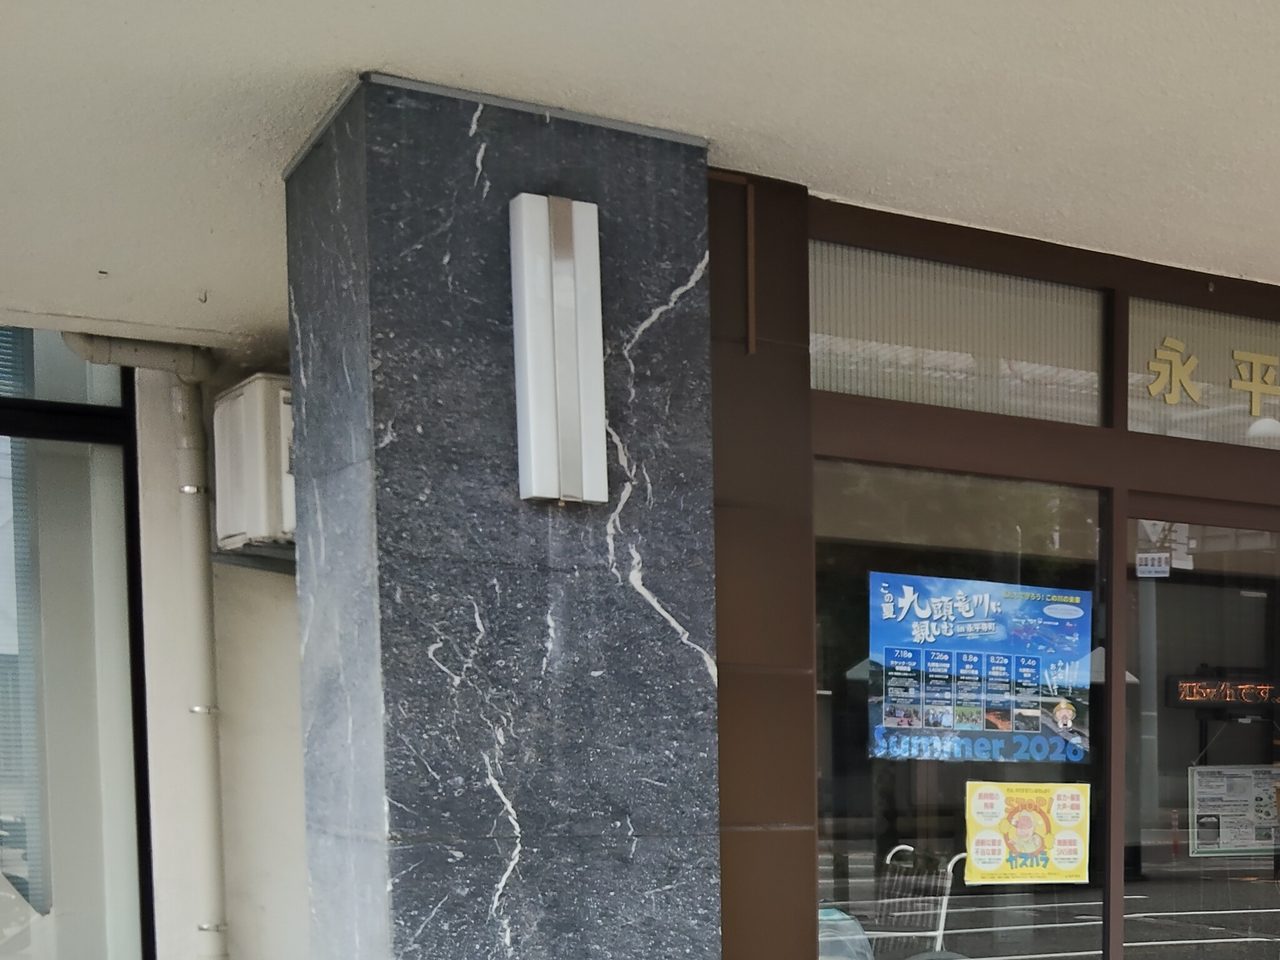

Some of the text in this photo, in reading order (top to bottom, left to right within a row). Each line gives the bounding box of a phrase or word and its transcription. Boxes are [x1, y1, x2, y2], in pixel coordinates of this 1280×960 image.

[897, 585, 1001, 621] 九頭竜川に
[912, 620, 954, 644] 親しむ
[874, 725, 1084, 762] Summer 2026
